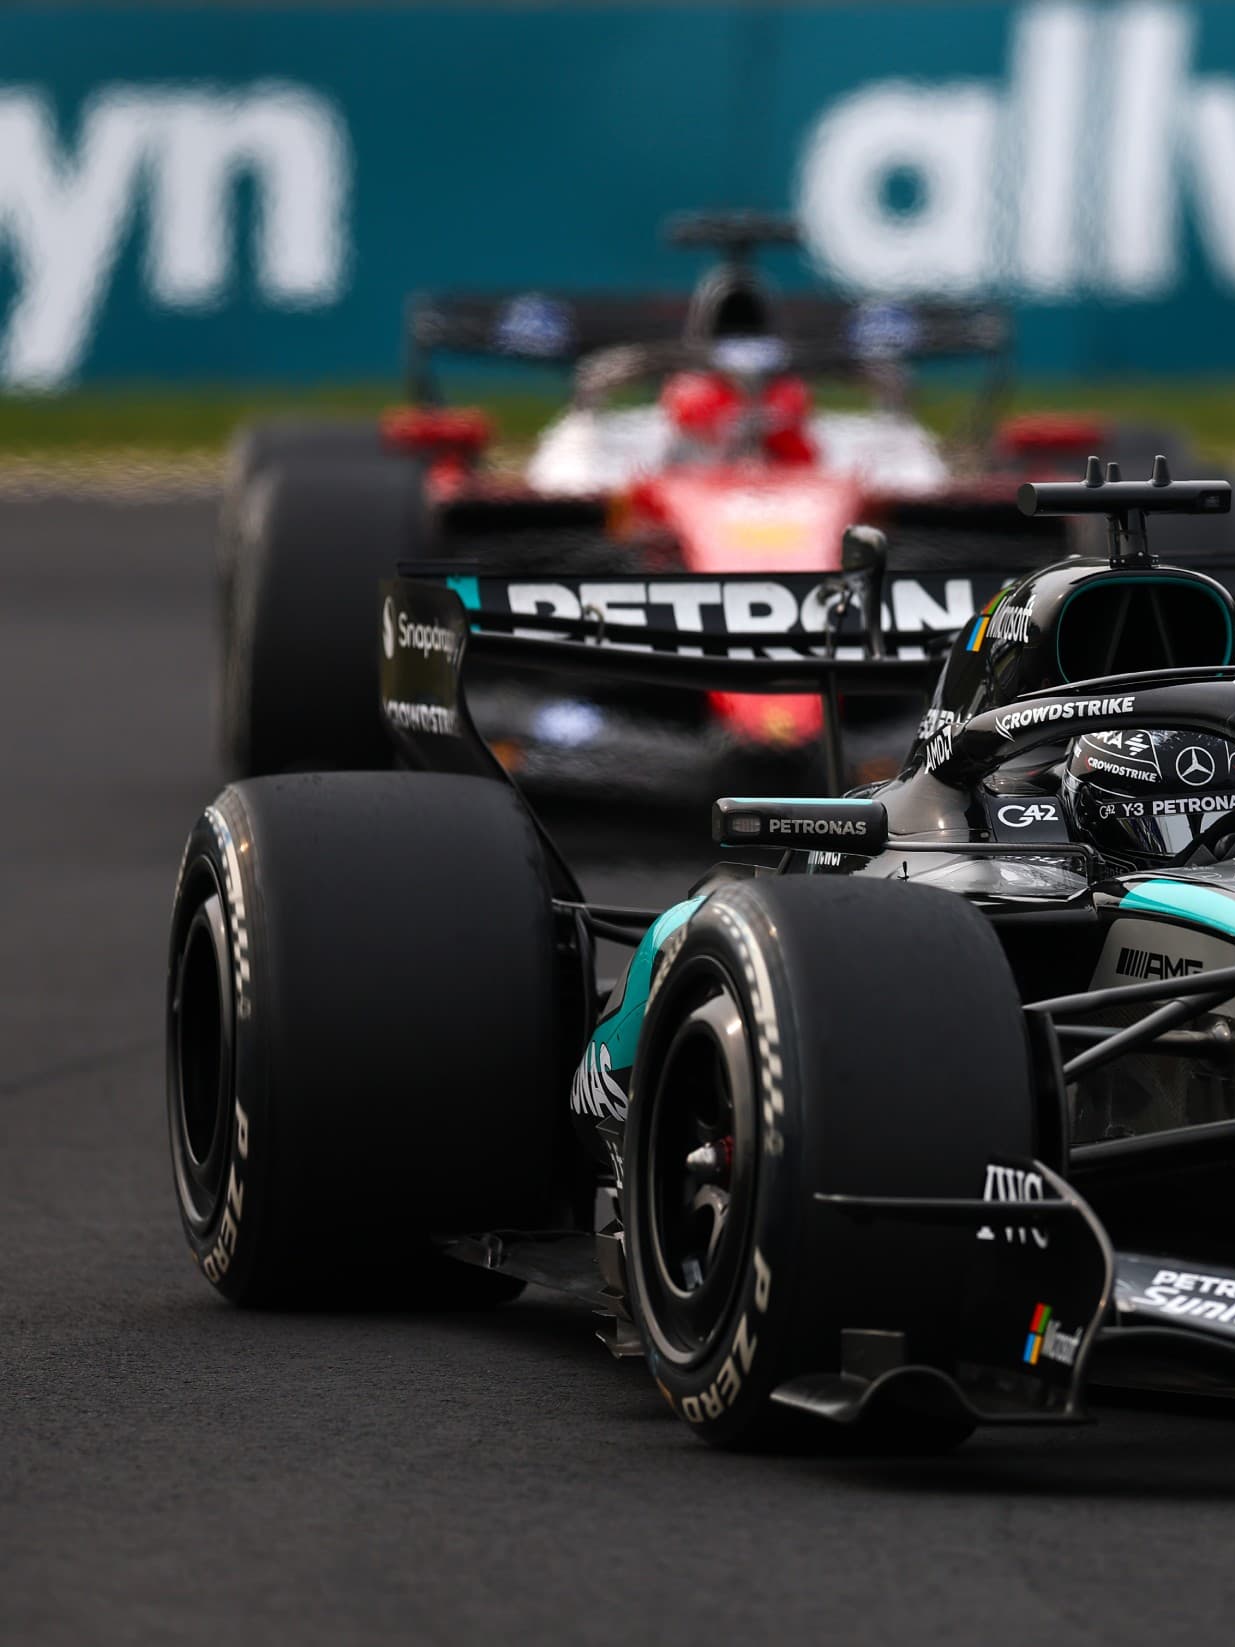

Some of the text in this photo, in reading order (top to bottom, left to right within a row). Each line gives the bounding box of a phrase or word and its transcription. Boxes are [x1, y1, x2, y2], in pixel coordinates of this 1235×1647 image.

[1001, 697, 1135, 731] CROWDSTRIKE
[1087, 757, 1158, 783] CROWDSTRIKE
[769, 818, 867, 836] PETRONAS
